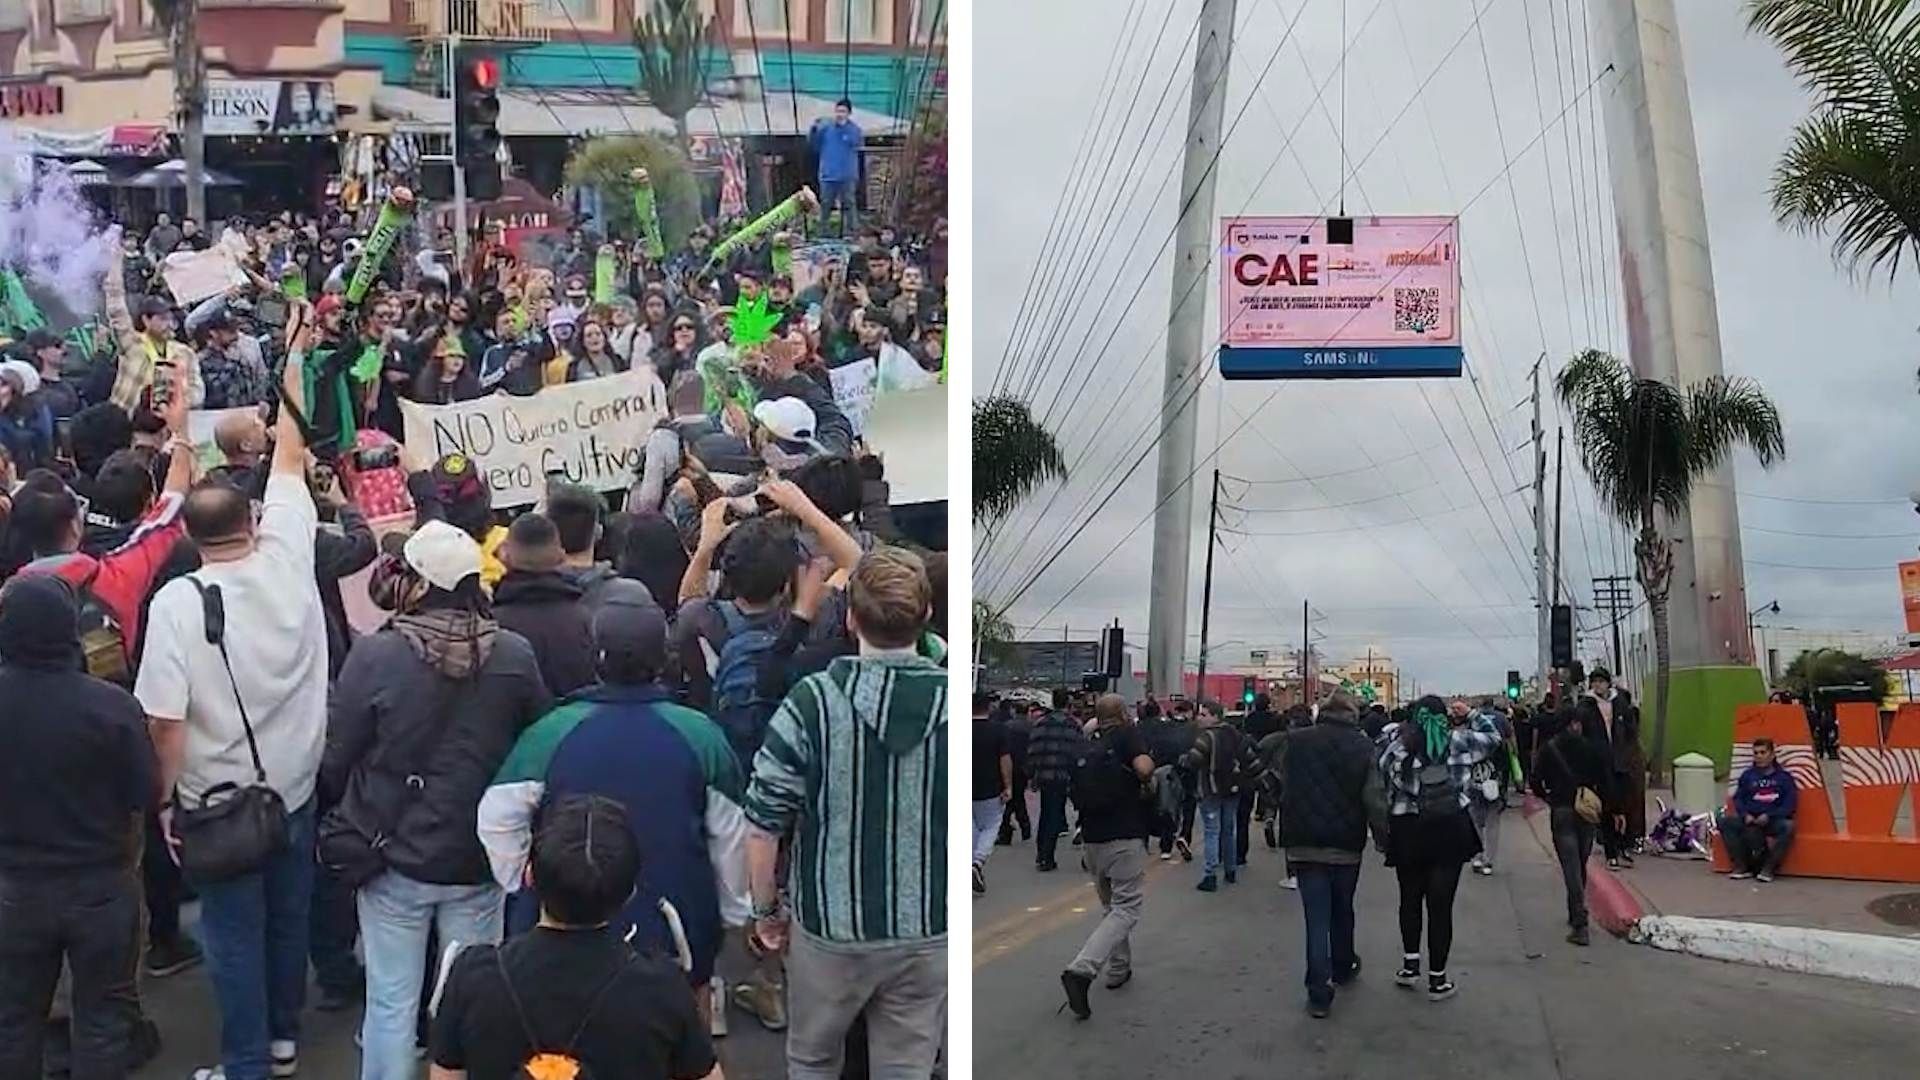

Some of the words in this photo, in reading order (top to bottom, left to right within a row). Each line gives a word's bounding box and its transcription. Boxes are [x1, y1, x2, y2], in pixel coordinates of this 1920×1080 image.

[204, 97, 270, 116] ELSON
[1235, 254, 1318, 286] CAE
[433, 412, 494, 456] NO
